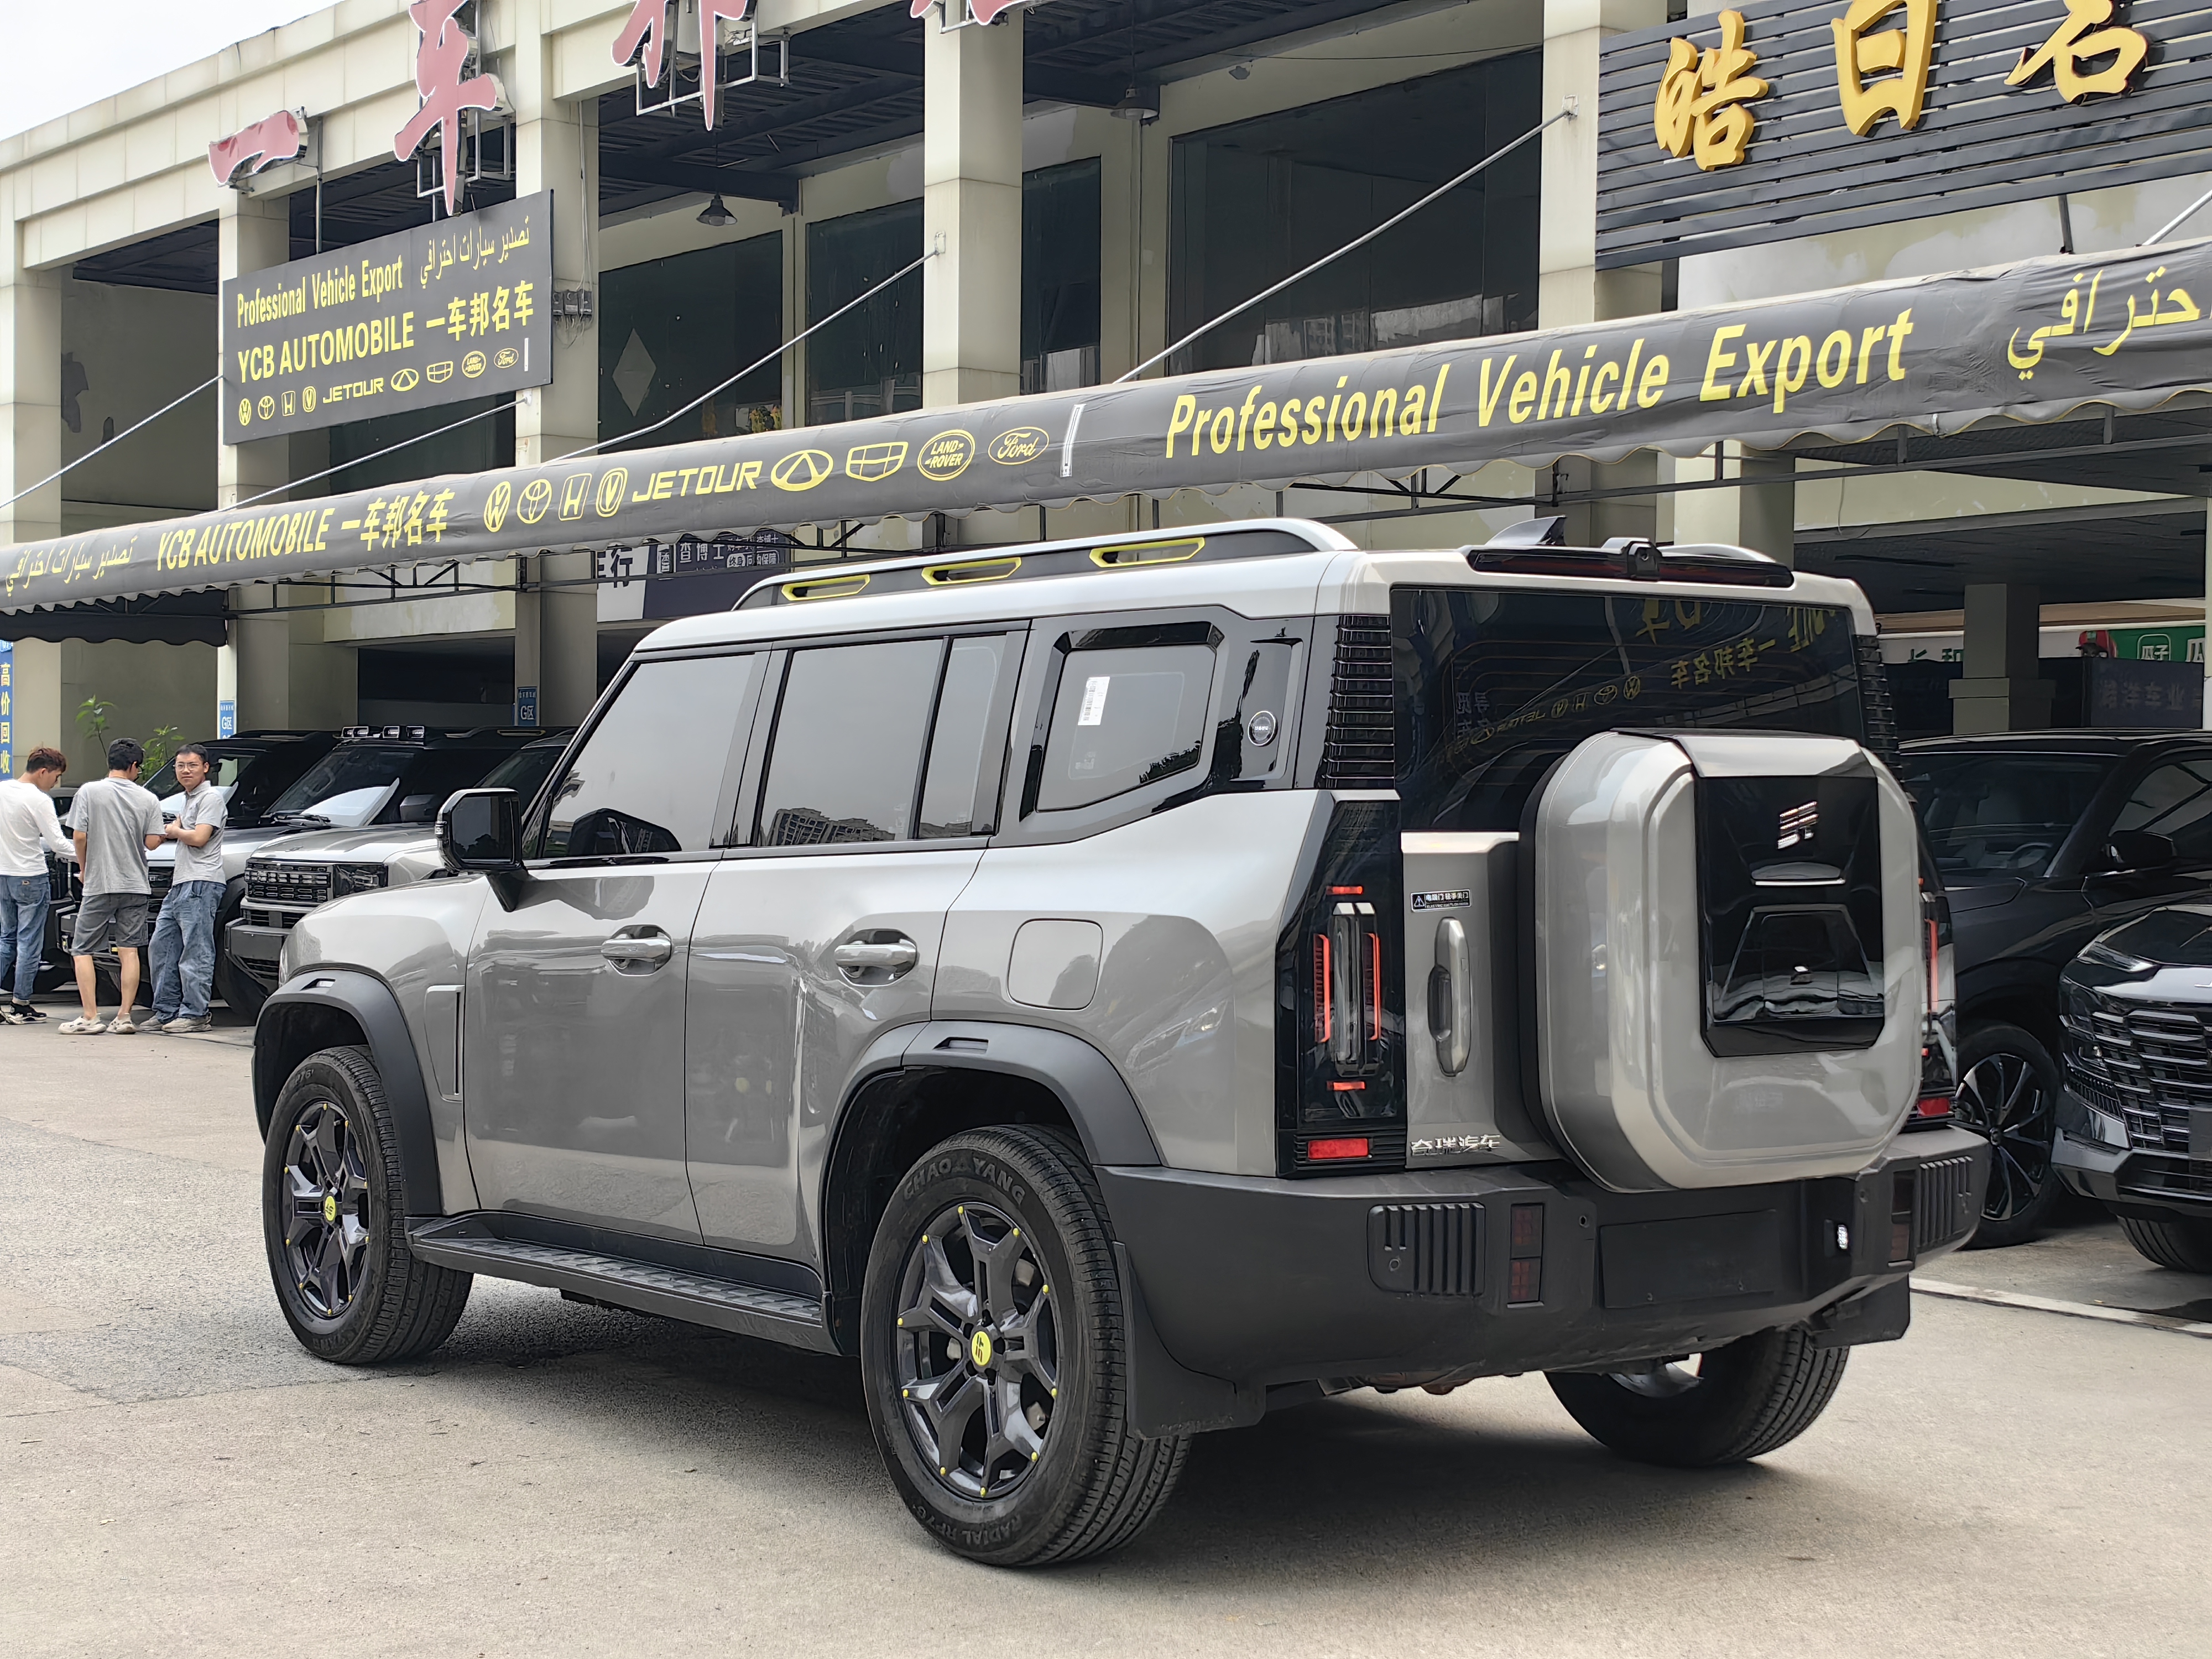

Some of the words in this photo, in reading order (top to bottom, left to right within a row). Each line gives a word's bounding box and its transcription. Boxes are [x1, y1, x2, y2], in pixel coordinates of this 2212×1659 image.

[420, 233, 456, 289] احترافي
[460, 226, 494, 270] سيارات
[498, 215, 529, 263] تصدير
[237, 277, 306, 327] Professional
[312, 265, 356, 309] Vehicle
[362, 255, 403, 302] Export
[426, 281, 534, 341] 一车邦名车
[238, 345, 275, 383] YCB
[280, 312, 414, 375] AUTOMOBILE
[2007, 267, 2211, 380] حترافي
[498, 351, 514, 366] Ford
[322, 377, 384, 404] JETOUR
[1166, 363, 1451, 459] Professional
[1478, 338, 1670, 427] Vehicle
[1699, 308, 1914, 414] Export
[929, 453, 964, 468] ROVER
[930, 440, 959, 455] LAND
[997, 432, 1039, 459] Ford
[632, 461, 763, 503] JETOUR
[157, 530, 195, 571] YCB
[195, 509, 335, 566] AUTOMOBILE
[342, 489, 455, 551] 一车邦名车
[52, 542, 92, 584] سيارات
[92, 535, 138, 580] تصدير
[904, 1159, 952, 1200] CHAO
[973, 1157, 1025, 1206] YANG
